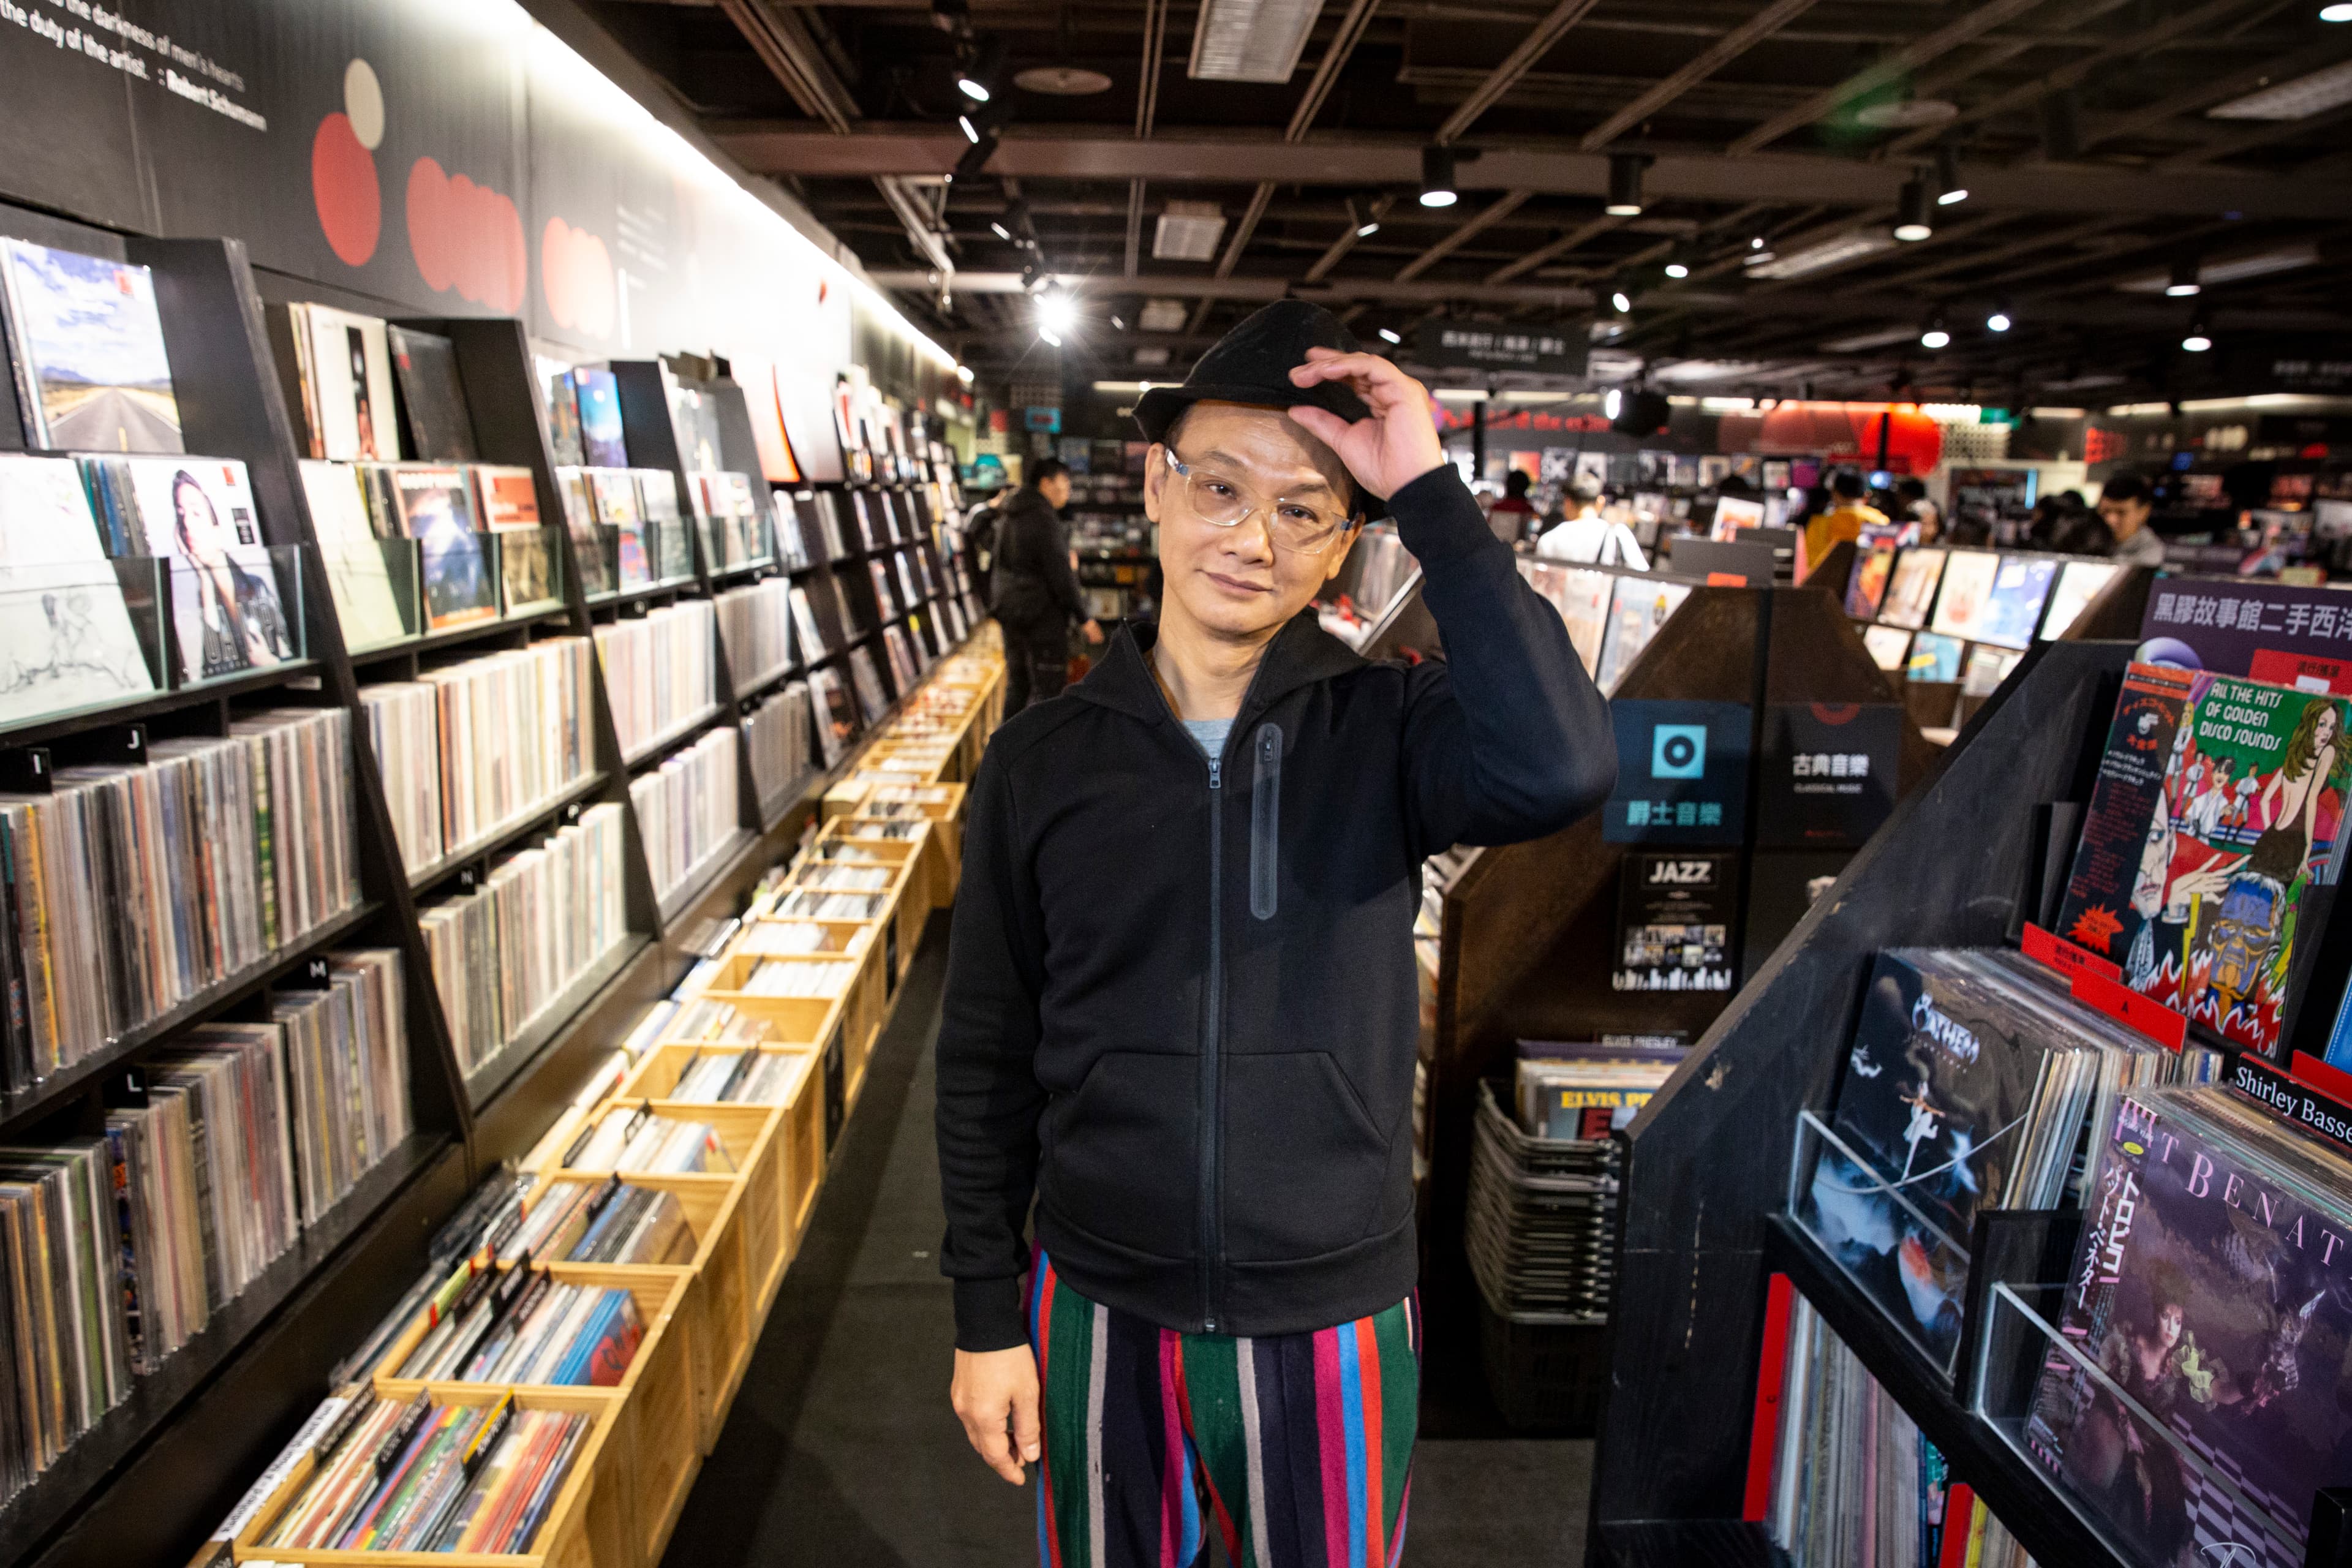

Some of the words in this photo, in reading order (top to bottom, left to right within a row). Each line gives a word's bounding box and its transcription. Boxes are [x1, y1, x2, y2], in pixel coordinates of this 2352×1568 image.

[30, 9, 64, 48] duty
[65, 28, 83, 51] of
[83, 34, 108, 64] the
[92, 4, 157, 50] darkness
[156, 35, 171, 57] of
[2210, 682, 2228, 699] ALL
[2230, 685, 2254, 704] THE
[2254, 690, 2283, 709] HITS
[2205, 701, 2222, 718] OF
[2223, 704, 2269, 728] GOLDEN
[127, 729, 140, 750] J
[2199, 720, 2233, 741] DISCO
[2232, 728, 2282, 751] SOUNDS
[1649, 861, 1712, 883] JAZZ
[309, 960, 326, 978] M
[2121, 1001, 2129, 1015] A
[127, 1073, 143, 1092] L
[2236, 1066, 2298, 1117] Shirley
[1561, 1091, 1621, 1109] ELVIS
[2102, 1171, 2140, 1274] トロピコ
[2185, 1151, 2352, 1281] BENAT
